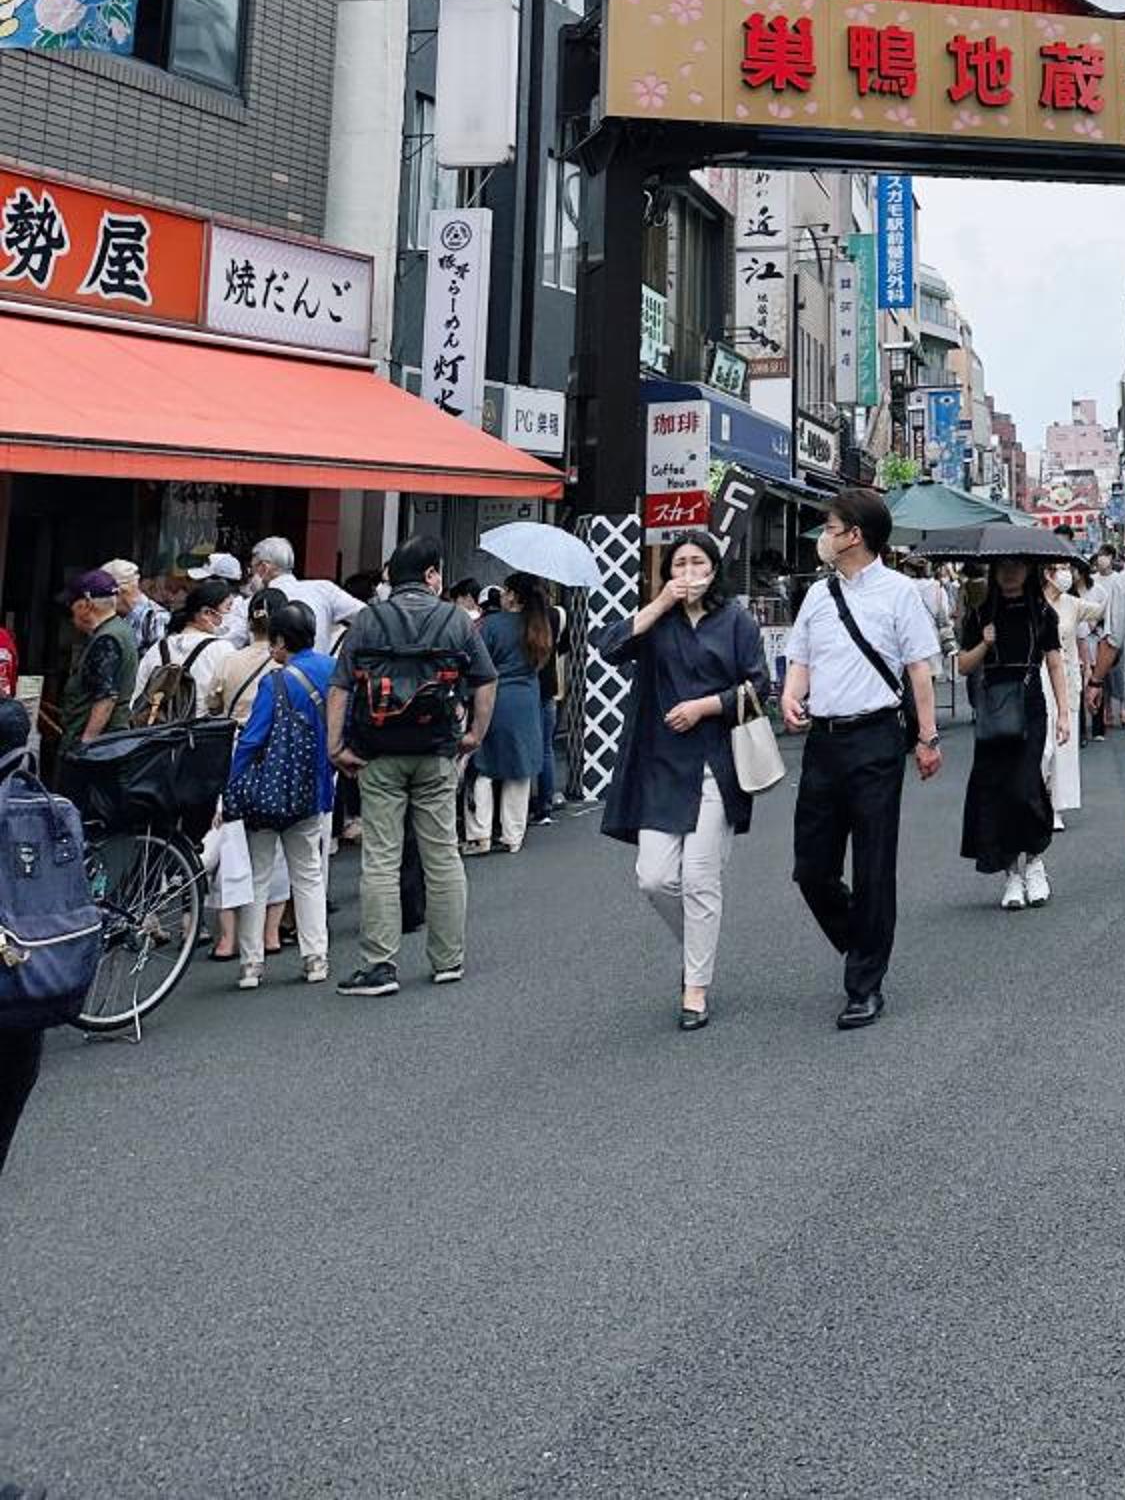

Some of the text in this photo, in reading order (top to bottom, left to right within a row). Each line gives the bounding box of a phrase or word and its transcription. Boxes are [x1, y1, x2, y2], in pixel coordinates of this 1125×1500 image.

[3, 190, 150, 302] 勢屋
[223, 257, 352, 323] 焼だんご
[652, 411, 701, 436] 珈琲
[651, 462, 686, 477] Coffee
[667, 478, 697, 489] House
[655, 496, 702, 521] スカイ
